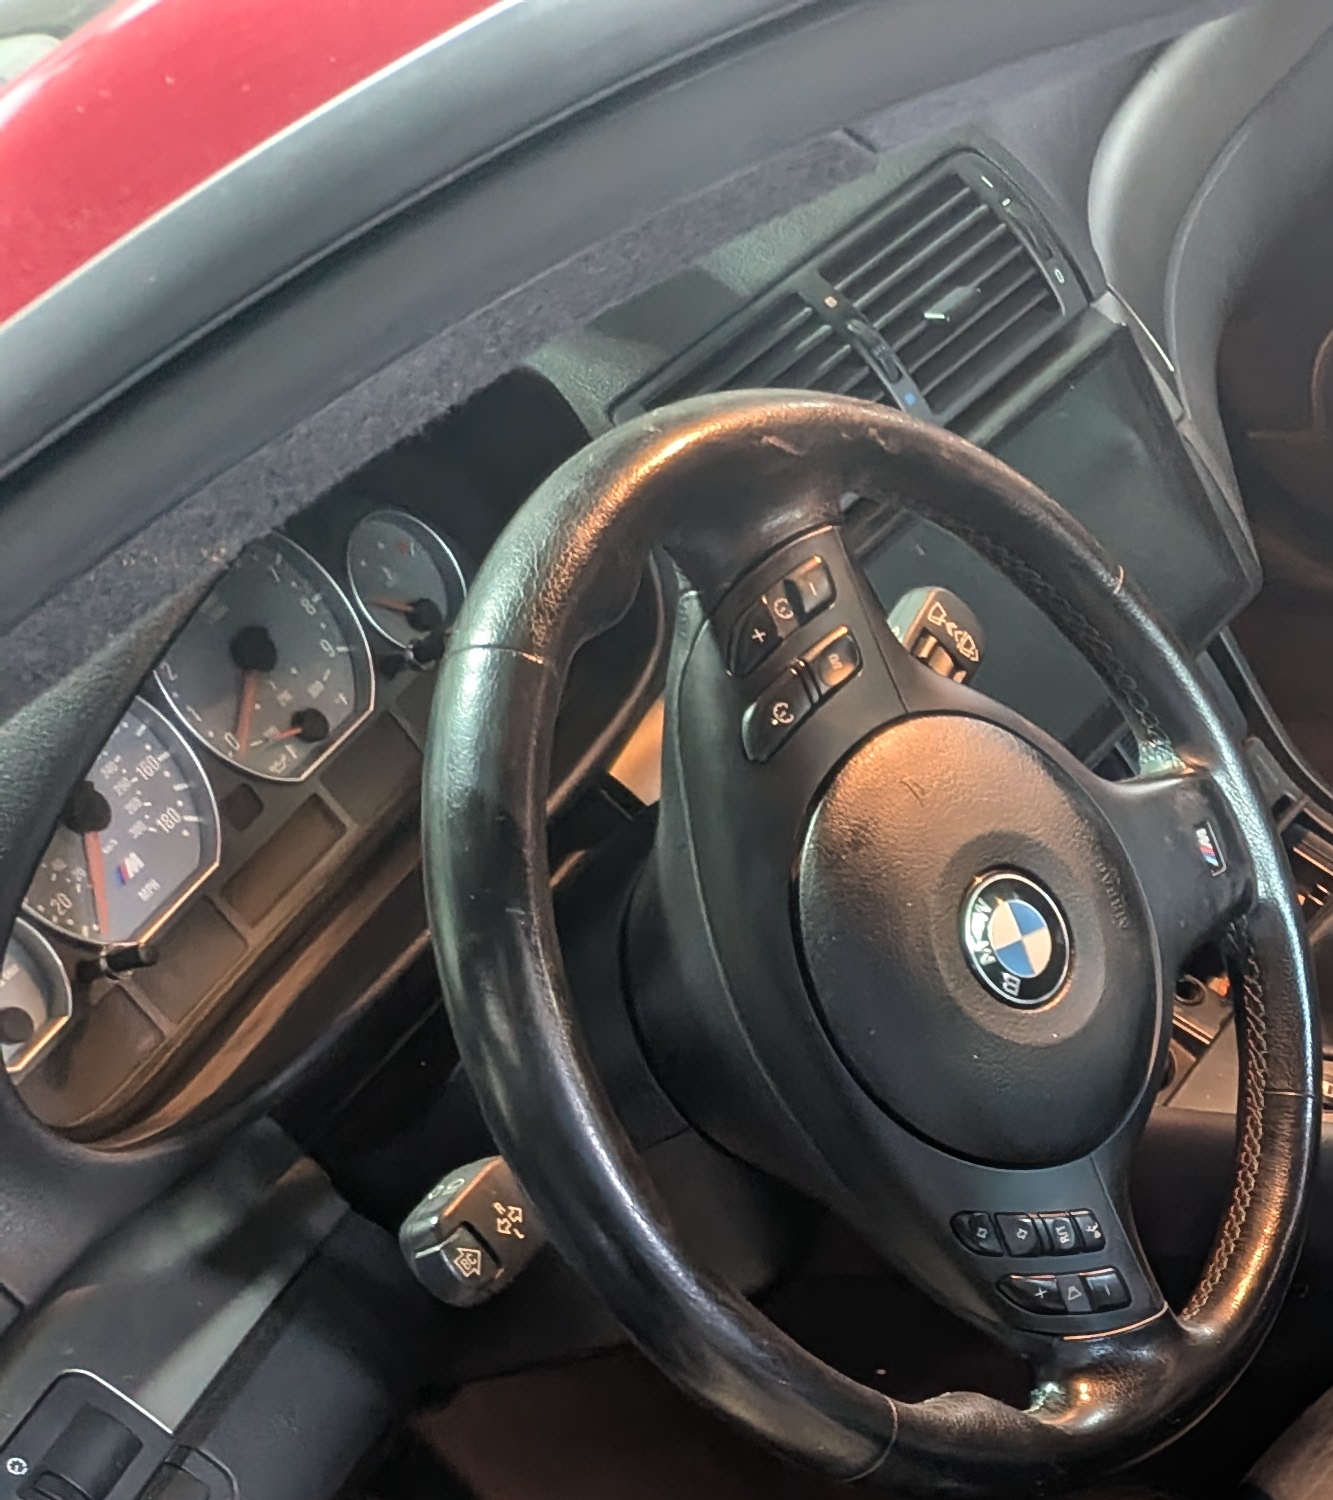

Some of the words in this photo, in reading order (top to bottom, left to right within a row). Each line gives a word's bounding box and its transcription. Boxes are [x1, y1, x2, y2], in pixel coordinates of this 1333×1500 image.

[301, 599, 317, 616] 8
[320, 638, 336, 657] 9
[159, 661, 178, 681] 2
[223, 731, 241, 751] 0
[135, 755, 160, 781] 160
[156, 806, 181, 833] 180
[138, 877, 161, 902] MPH
[50, 892, 72, 916] 20
[969, 897, 1021, 997] BMW
